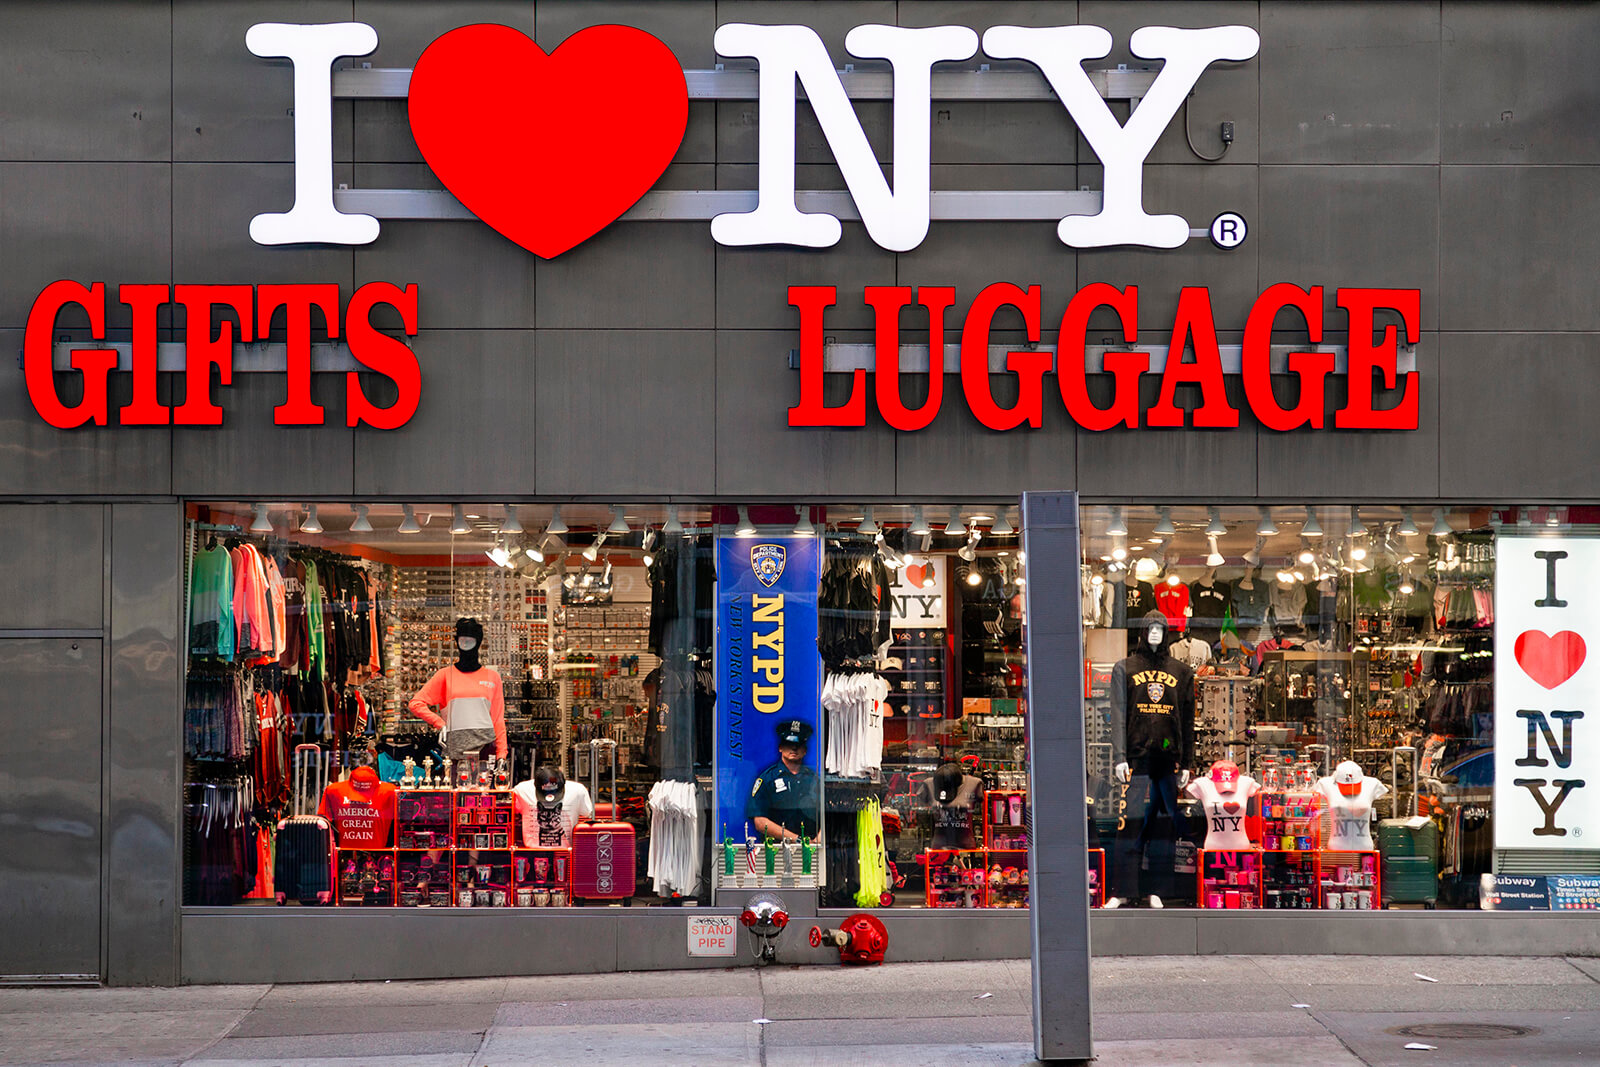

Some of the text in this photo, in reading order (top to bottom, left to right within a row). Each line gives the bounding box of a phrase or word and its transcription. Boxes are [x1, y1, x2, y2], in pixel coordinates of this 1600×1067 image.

[246, 22, 380, 245] I
[711, 23, 1261, 252] NY
[23, 279, 422, 430] GIFTS
[787, 281, 1422, 432] LUGGAGE
[1534, 551, 1568, 607] I
[891, 594, 941, 618] NY
[752, 593, 785, 714] NYPD
[730, 592, 744, 761] NEW YORK'S FINEST
[1132, 670, 1178, 688] NYPD
[337, 807, 380, 817] AMERICA
[1211, 801, 1222, 816] I
[342, 819, 374, 828] GREAT
[1211, 815, 1243, 832] NY
[1333, 818, 1369, 837] NY
[342, 831, 374, 840] AGAIN
[1490, 876, 1537, 888] Subway
[1558, 878, 1600, 888] Subwa
[691, 925, 733, 935] STAND
[698, 937, 726, 948] PIPE
